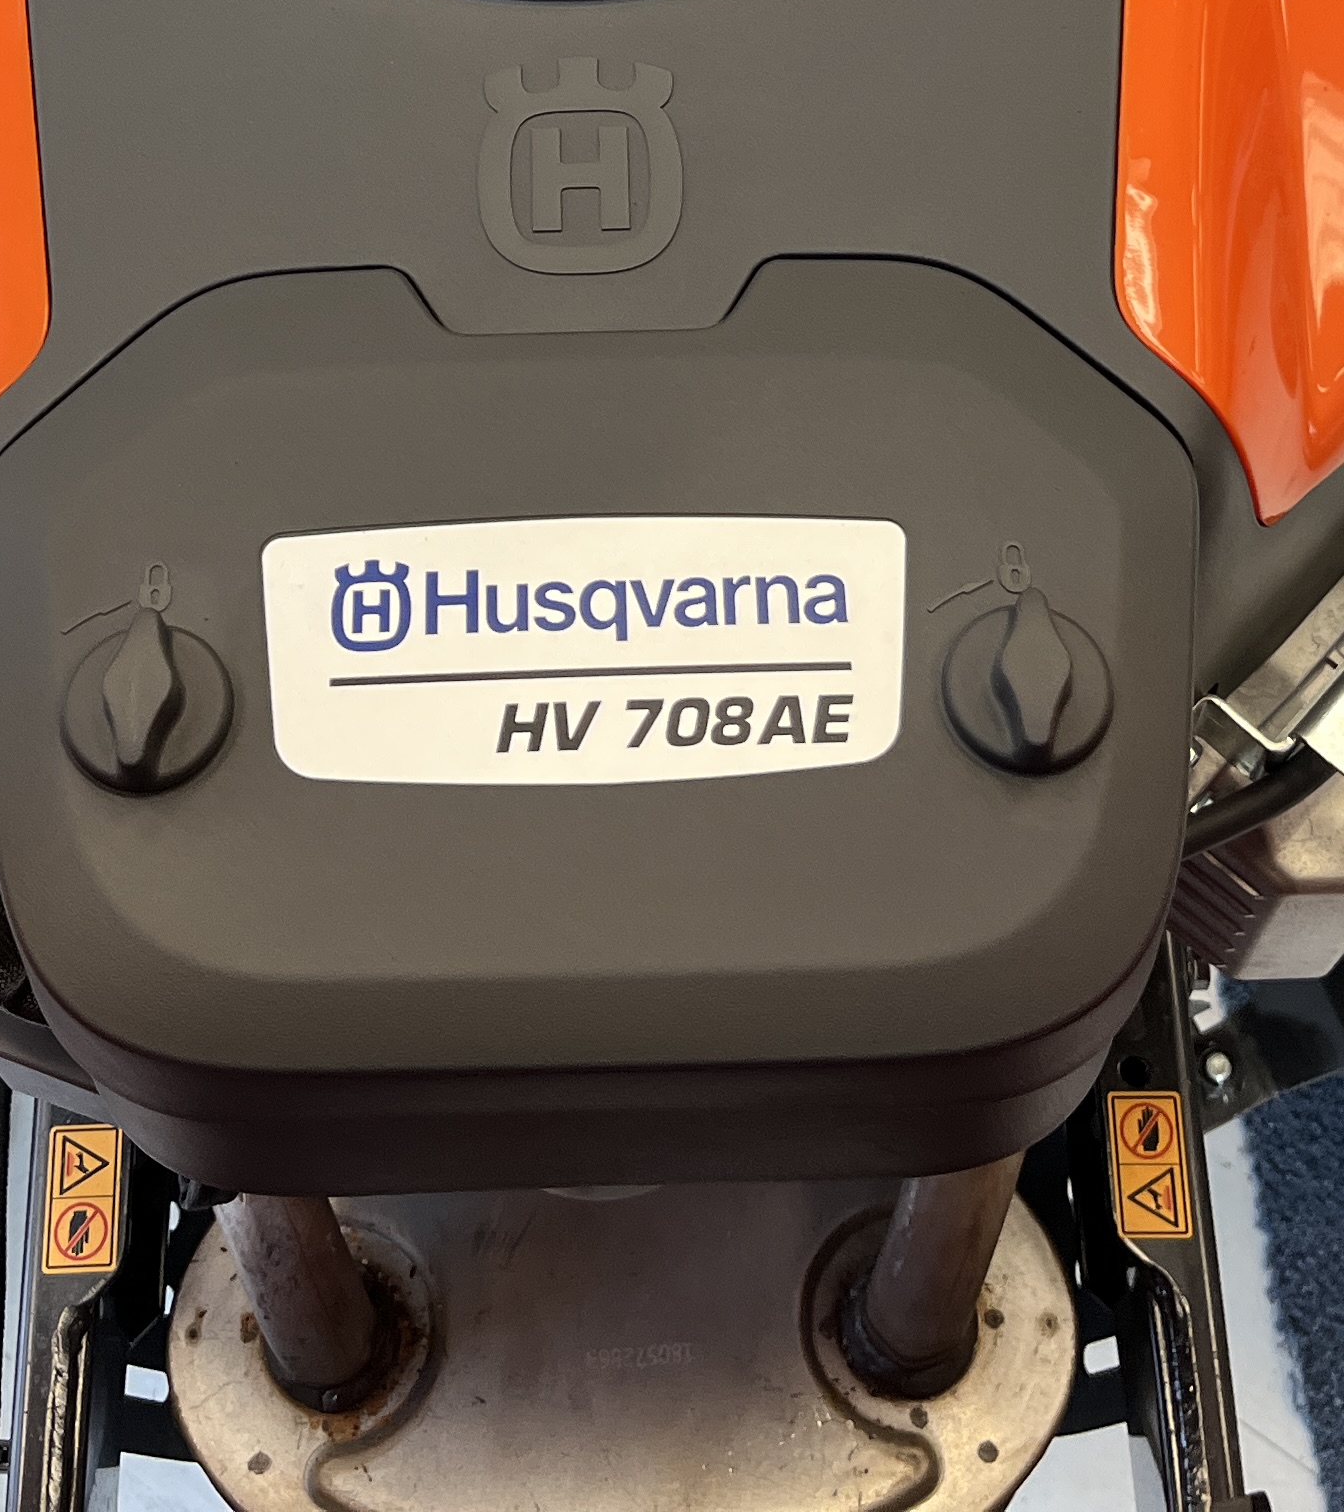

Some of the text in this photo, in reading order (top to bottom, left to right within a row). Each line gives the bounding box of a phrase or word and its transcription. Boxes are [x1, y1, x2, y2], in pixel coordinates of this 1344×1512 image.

[424, 570, 849, 641] Husqvarna
[495, 694, 854, 753] HV 708AE
